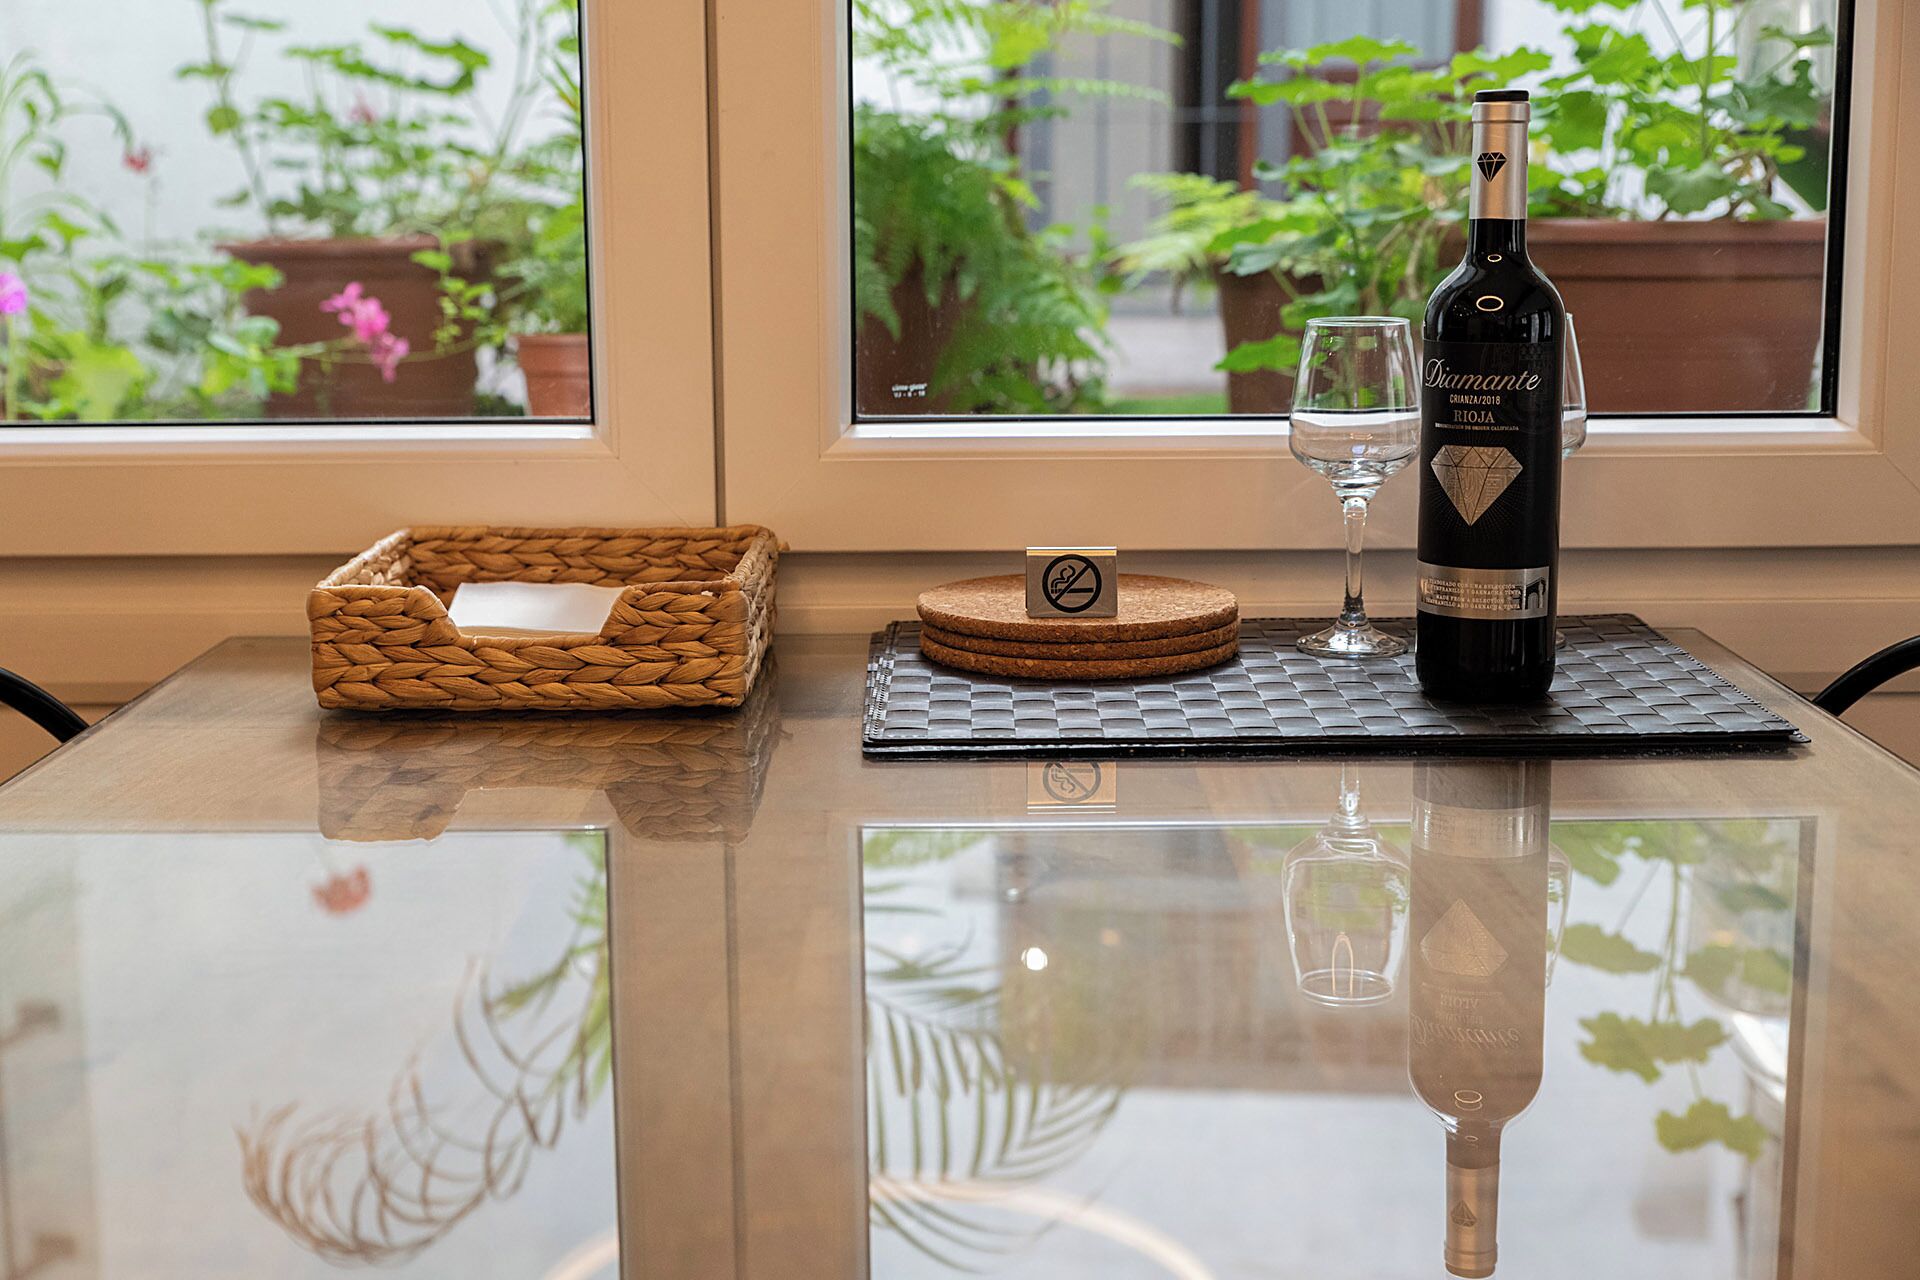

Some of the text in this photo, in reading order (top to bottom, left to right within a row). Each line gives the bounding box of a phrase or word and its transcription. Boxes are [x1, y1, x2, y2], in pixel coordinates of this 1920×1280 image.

[1425, 358, 1542, 391] Diamante
[1449, 394, 1501, 406] CRIANZA/2018
[1454, 410, 1495, 423] RIOJA
